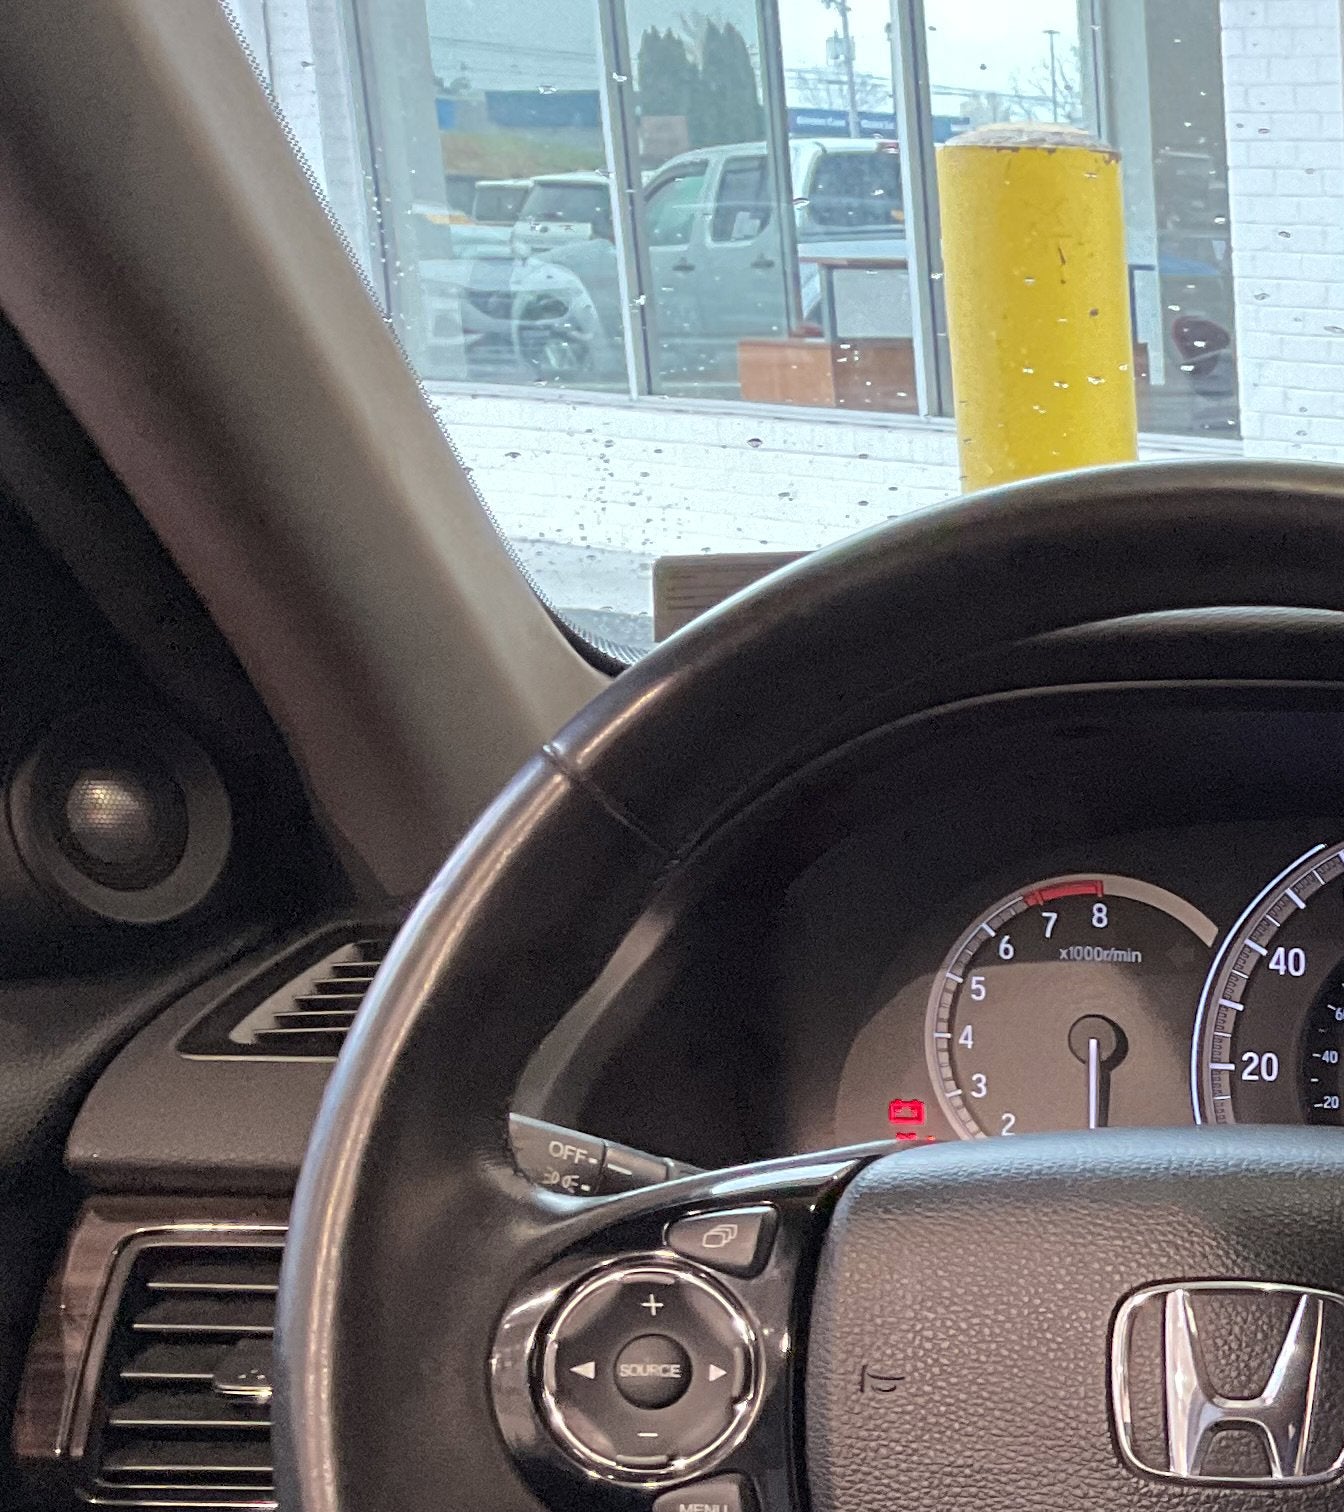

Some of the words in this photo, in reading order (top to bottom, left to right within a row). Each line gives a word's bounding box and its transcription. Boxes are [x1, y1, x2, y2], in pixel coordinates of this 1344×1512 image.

[1042, 911, 1058, 938] 7
[1093, 903, 1107, 928] 8
[999, 936, 1014, 960] 6
[1059, 946, 1142, 964] x1000r/min
[1269, 947, 1306, 976] 40
[970, 976, 986, 1001] 5
[959, 1025, 974, 1049] 4
[1241, 1052, 1279, 1081] 20
[1322, 1050, 1338, 1064] 40
[971, 1074, 987, 1098] 3
[1324, 1096, 1339, 1109] 20
[1001, 1113, 1016, 1137] 2
[549, 1141, 588, 1164] OFF
[620, 1363, 682, 1378] SOURCE
